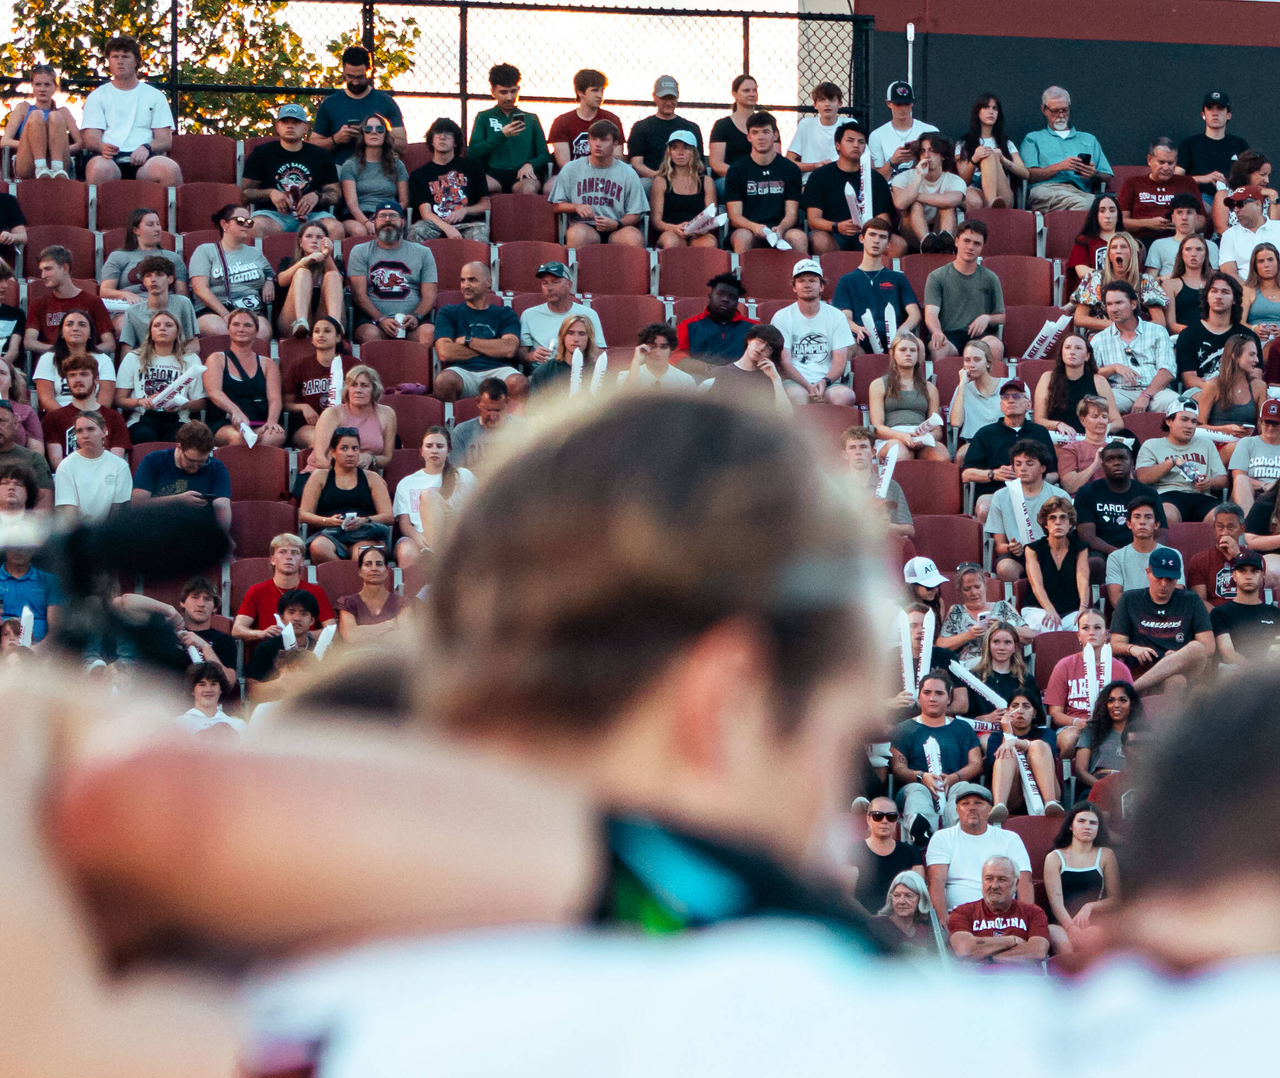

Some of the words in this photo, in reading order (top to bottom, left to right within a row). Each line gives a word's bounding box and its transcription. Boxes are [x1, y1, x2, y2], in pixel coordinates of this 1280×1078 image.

[1052, 328, 1065, 344] FALL
[793, 344, 828, 354] HAMPION
[1026, 345, 1040, 360] NEXT
[1036, 332, 1050, 347] FALL
[1097, 503, 1127, 513] CAROL
[972, 917, 1027, 931] CAROLINA
